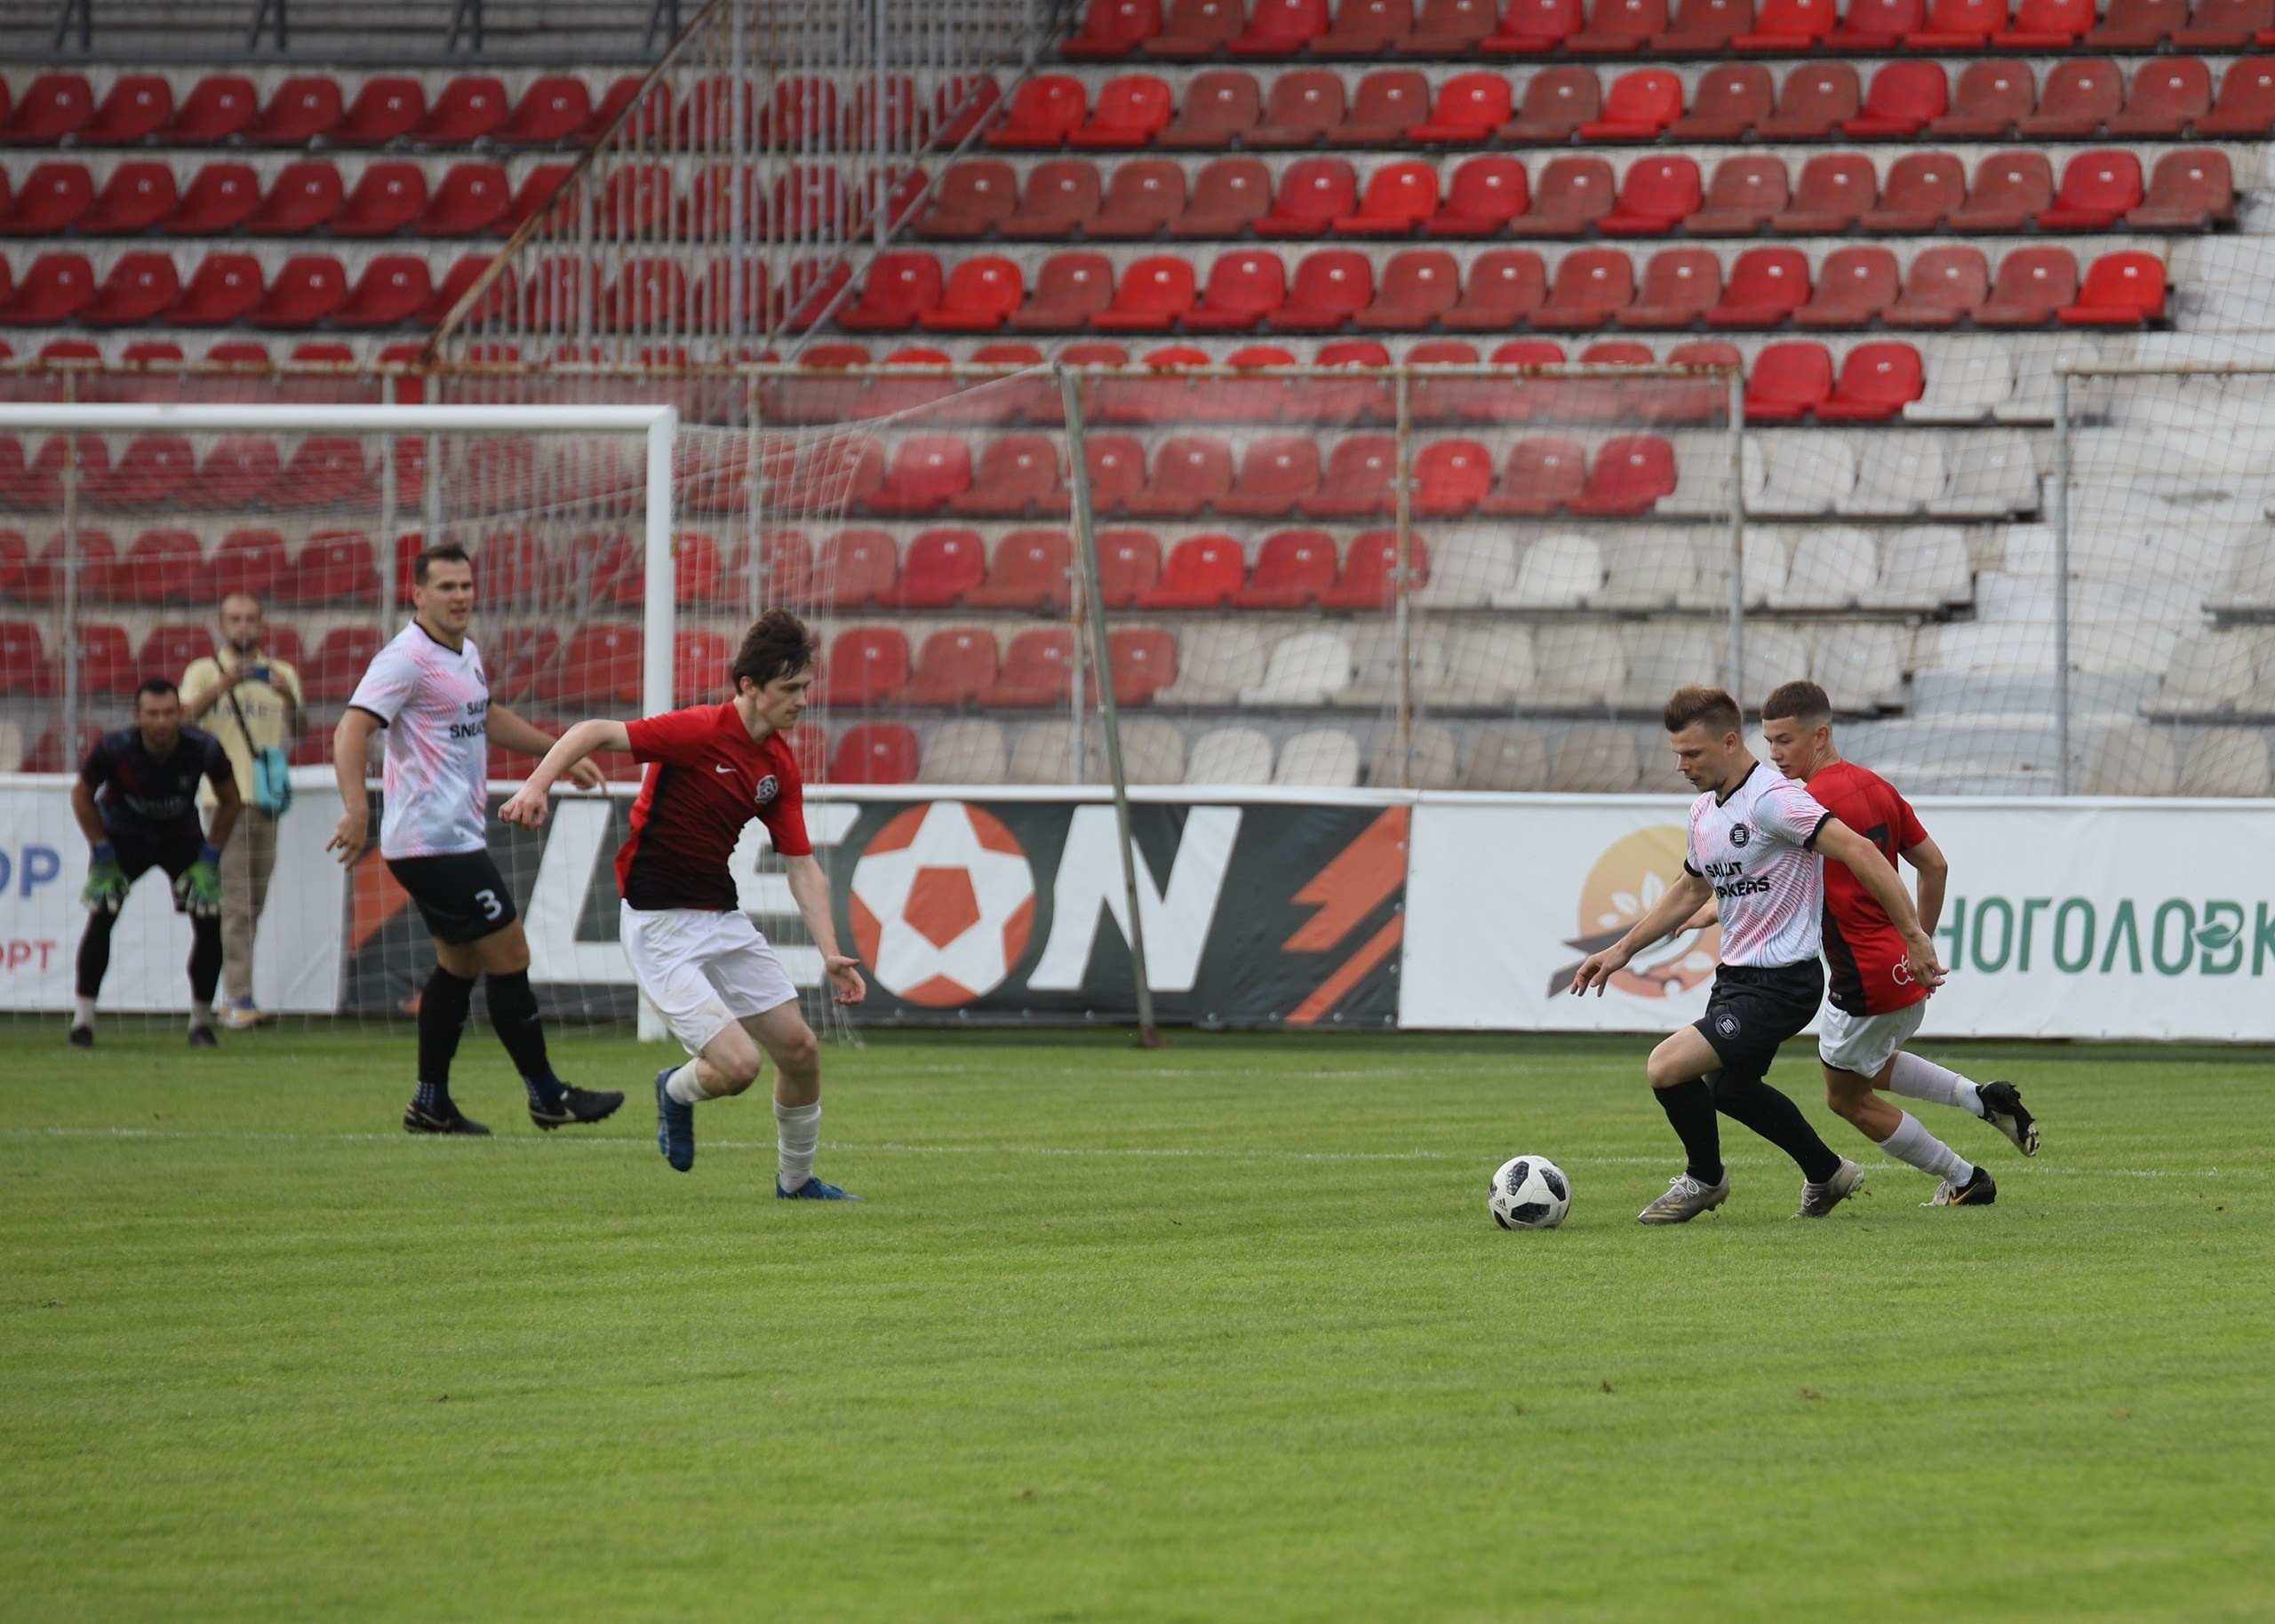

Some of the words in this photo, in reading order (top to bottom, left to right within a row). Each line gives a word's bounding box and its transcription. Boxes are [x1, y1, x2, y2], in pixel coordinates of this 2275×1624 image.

[0, 847, 60, 898] Р
[1712, 876, 1770, 899] AKERS
[475, 888, 502, 920] 3
[0, 938, 56, 970] РТ
